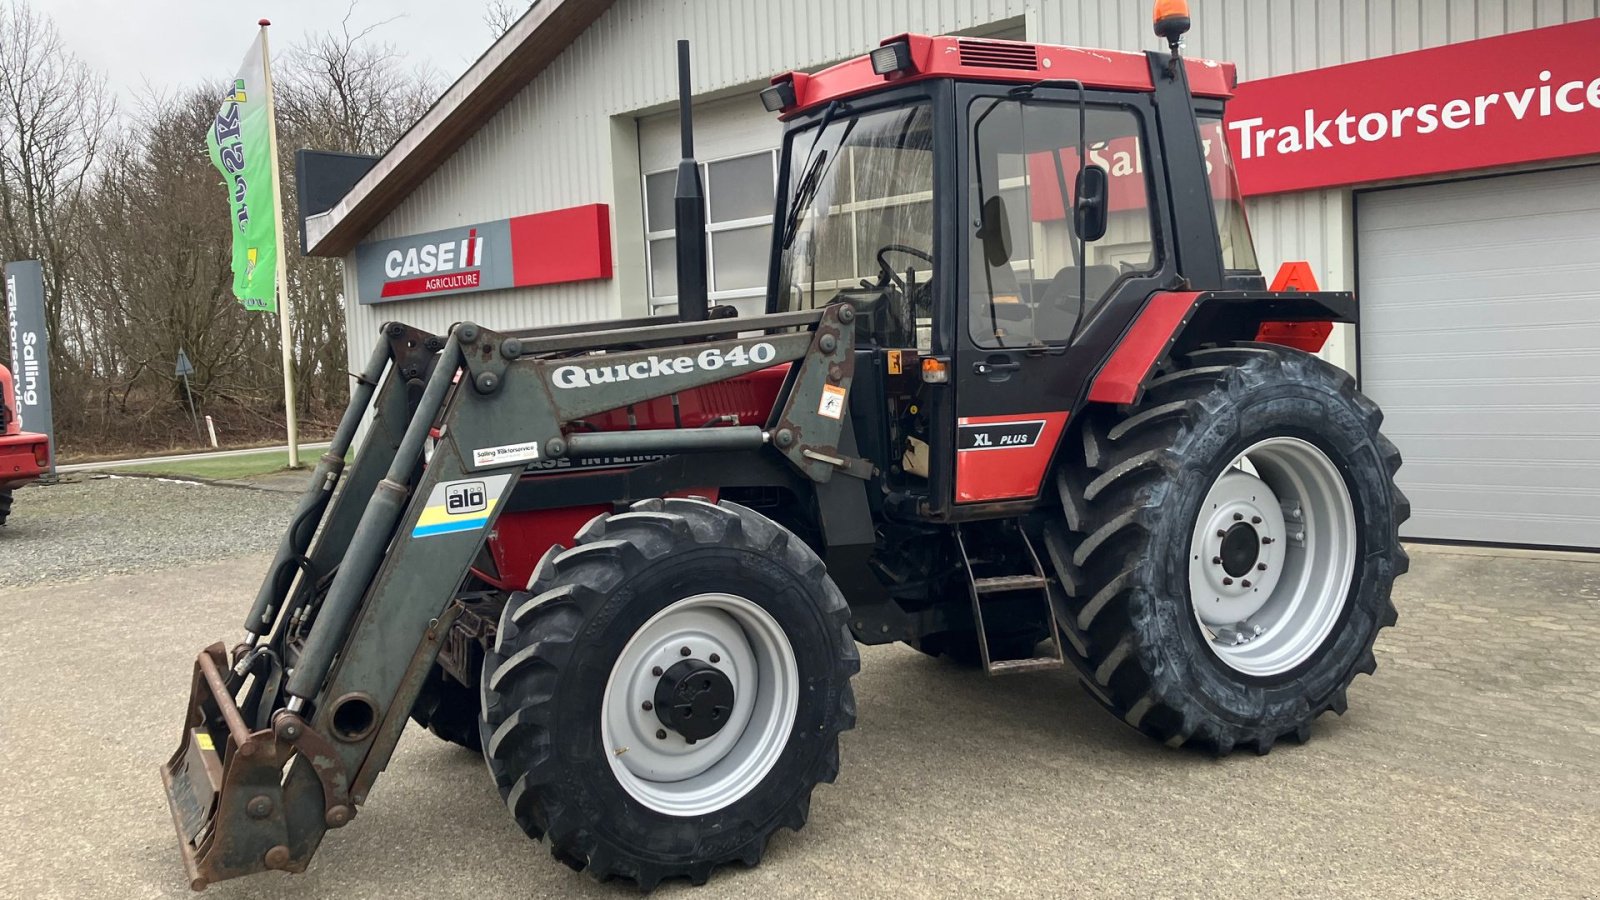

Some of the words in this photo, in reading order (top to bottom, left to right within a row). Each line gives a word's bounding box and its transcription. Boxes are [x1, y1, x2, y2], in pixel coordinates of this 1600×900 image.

[385, 241, 456, 279] CASE
[425, 273, 478, 290] AGRICULTURE
[22, 331, 39, 406] Salling
[551, 355, 694, 389] Quicke
[697, 342, 776, 371] 640
[973, 433, 993, 446] XL
[999, 434, 1028, 445] PLUS
[477, 450, 496, 458] Salling
[526, 457, 571, 470] ASE
